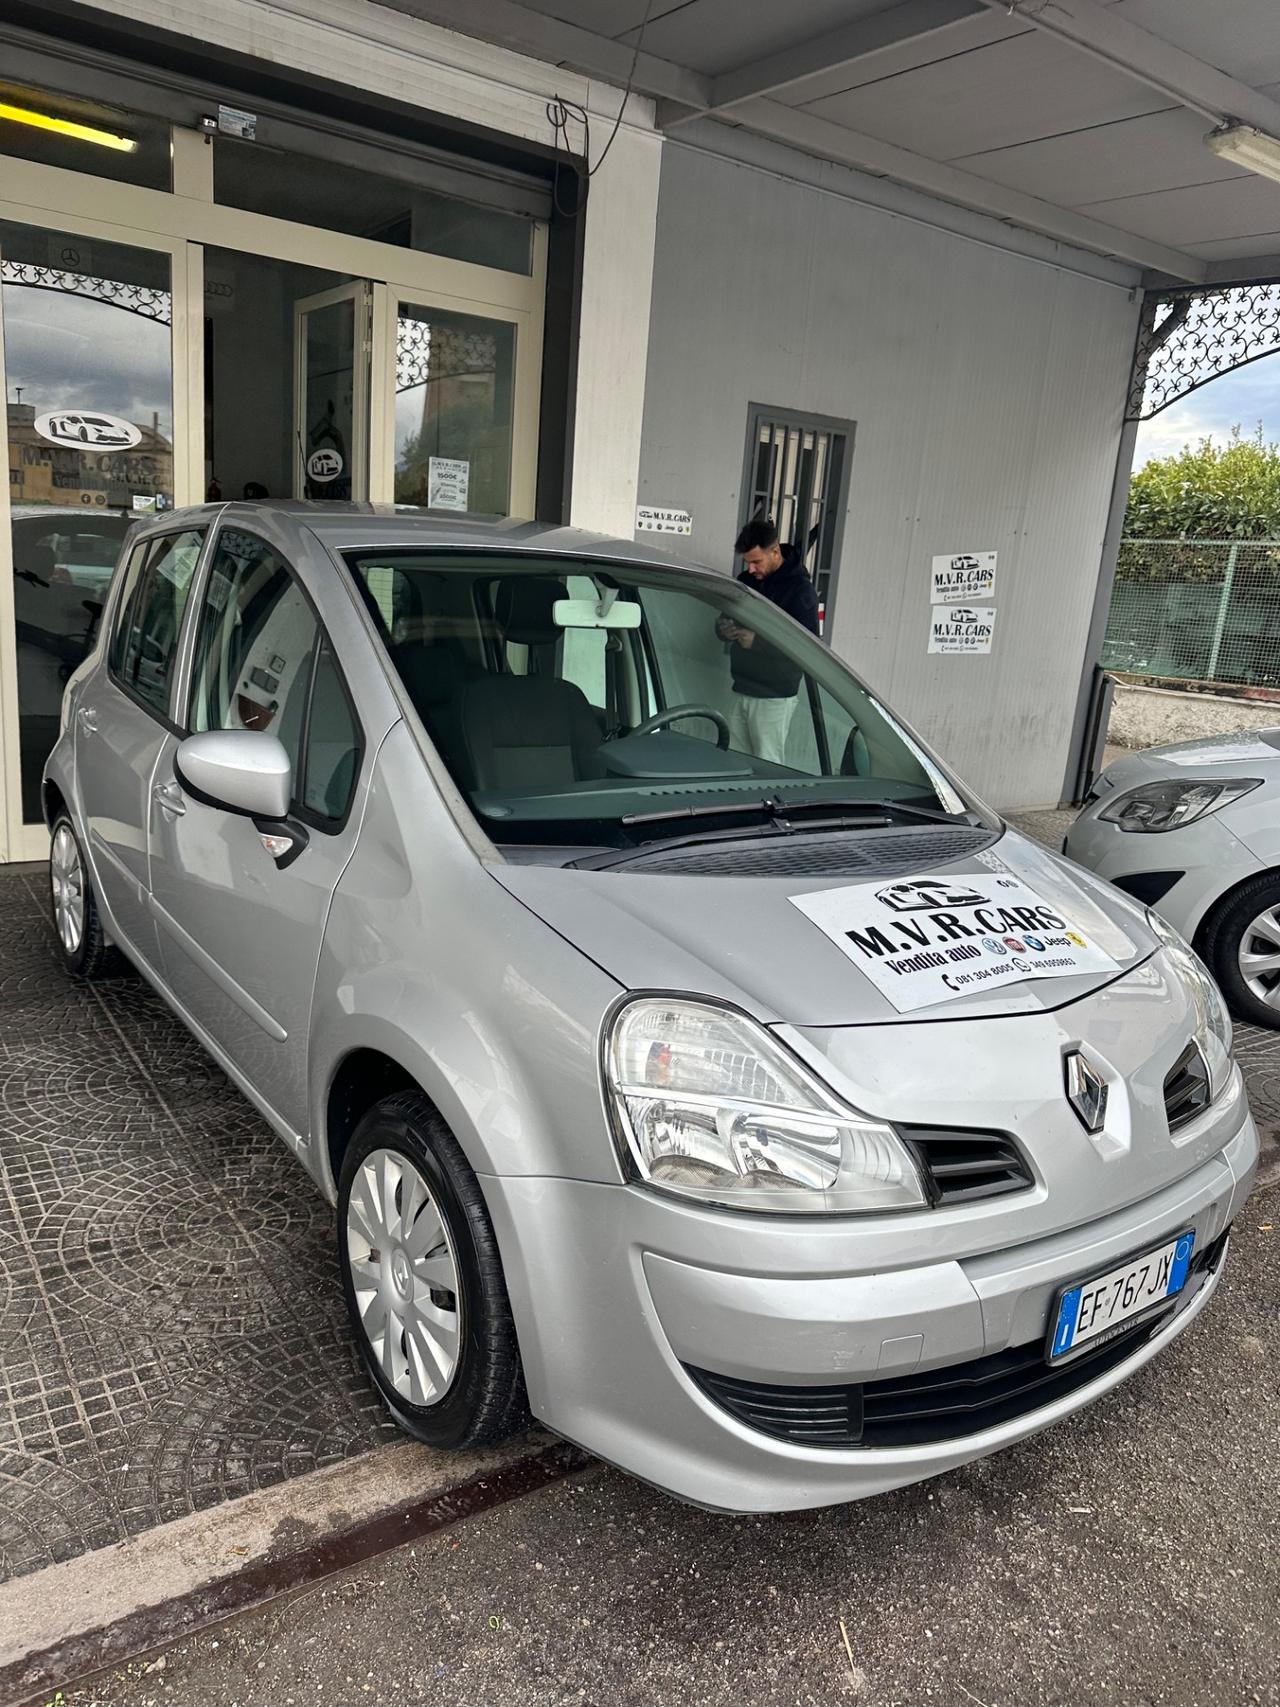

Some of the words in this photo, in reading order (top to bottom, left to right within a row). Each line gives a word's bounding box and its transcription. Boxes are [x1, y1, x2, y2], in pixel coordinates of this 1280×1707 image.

[845, 906, 1067, 959] M.V.R.CARS
[1043, 935, 1072, 947] Jeep
[884, 950, 947, 976] Vendita
[945, 944, 982, 964] auto
[955, 974, 974, 985] 081
[973, 970, 993, 980] 304
[990, 963, 1015, 975] 8005
